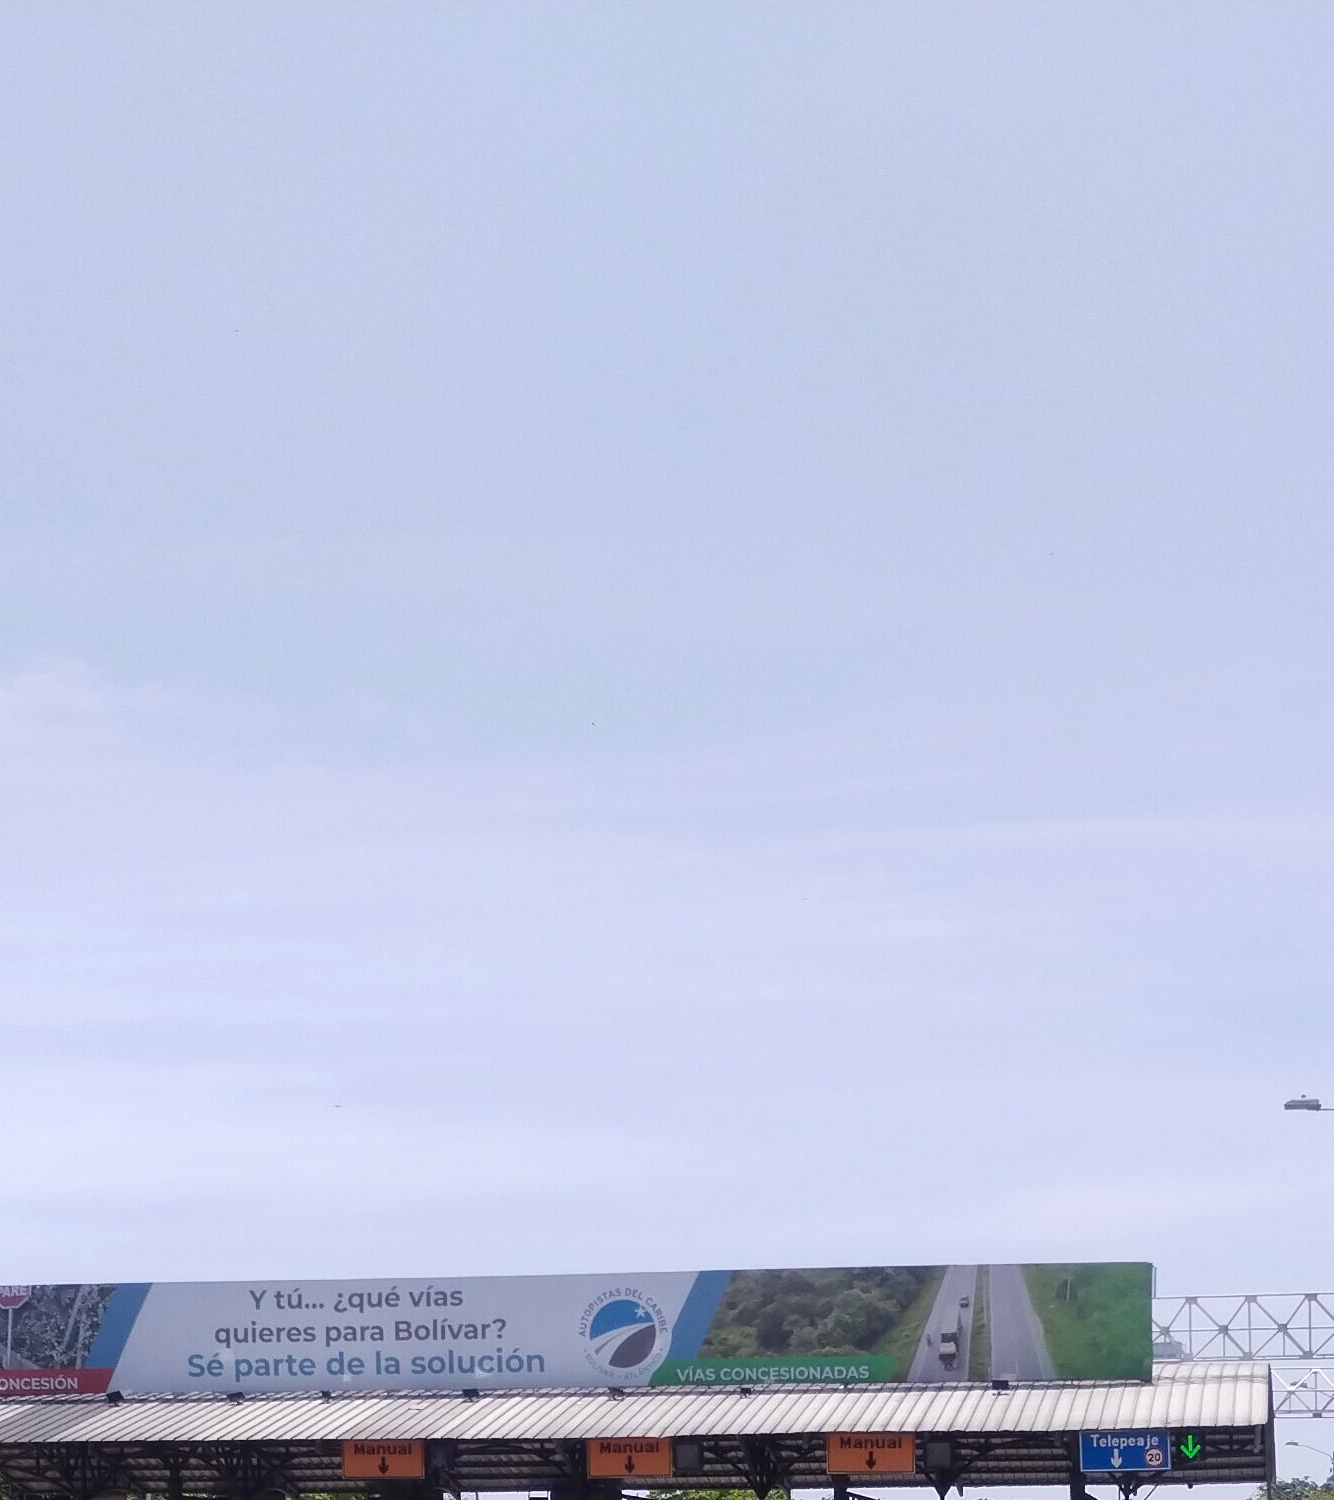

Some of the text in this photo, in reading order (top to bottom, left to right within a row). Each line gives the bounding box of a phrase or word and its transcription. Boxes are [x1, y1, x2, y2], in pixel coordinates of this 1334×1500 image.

[249, 1285, 464, 1313] Y tú... ¿qué vías
[578, 1287, 668, 1337] AUTOPISTAS DEL CARIBE
[215, 1318, 507, 1348] quieres para Bolívar?
[187, 1347, 546, 1382] Sé parte de la solución
[676, 1365, 870, 1382] VÍAS CONCESIONADAS
[354, 1443, 412, 1455] Manual
[599, 1441, 660, 1454] Manual
[840, 1437, 902, 1449] Manual
[1090, 1434, 1159, 1450] Telepeaje
[1147, 1453, 1161, 1462] 20
